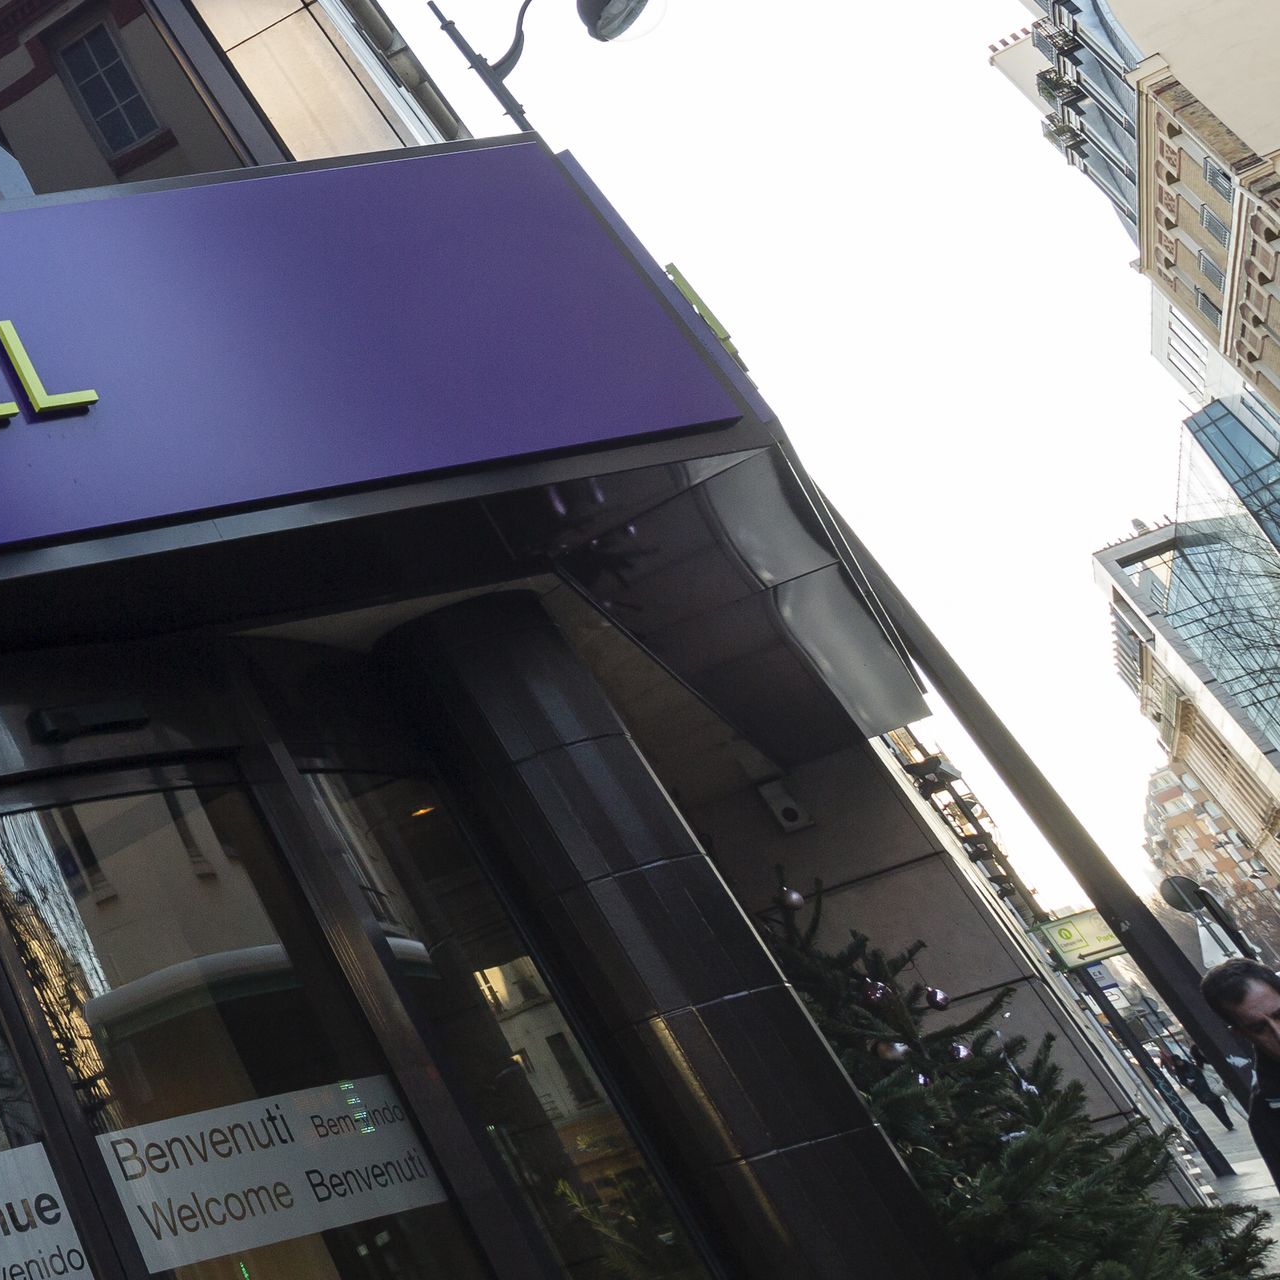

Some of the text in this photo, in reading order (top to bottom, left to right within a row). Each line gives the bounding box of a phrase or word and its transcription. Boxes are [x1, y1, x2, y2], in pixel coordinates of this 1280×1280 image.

[110, 1104, 295, 1182] Benvenuti
[137, 1148, 429, 1241] Welcome Benvenuti
